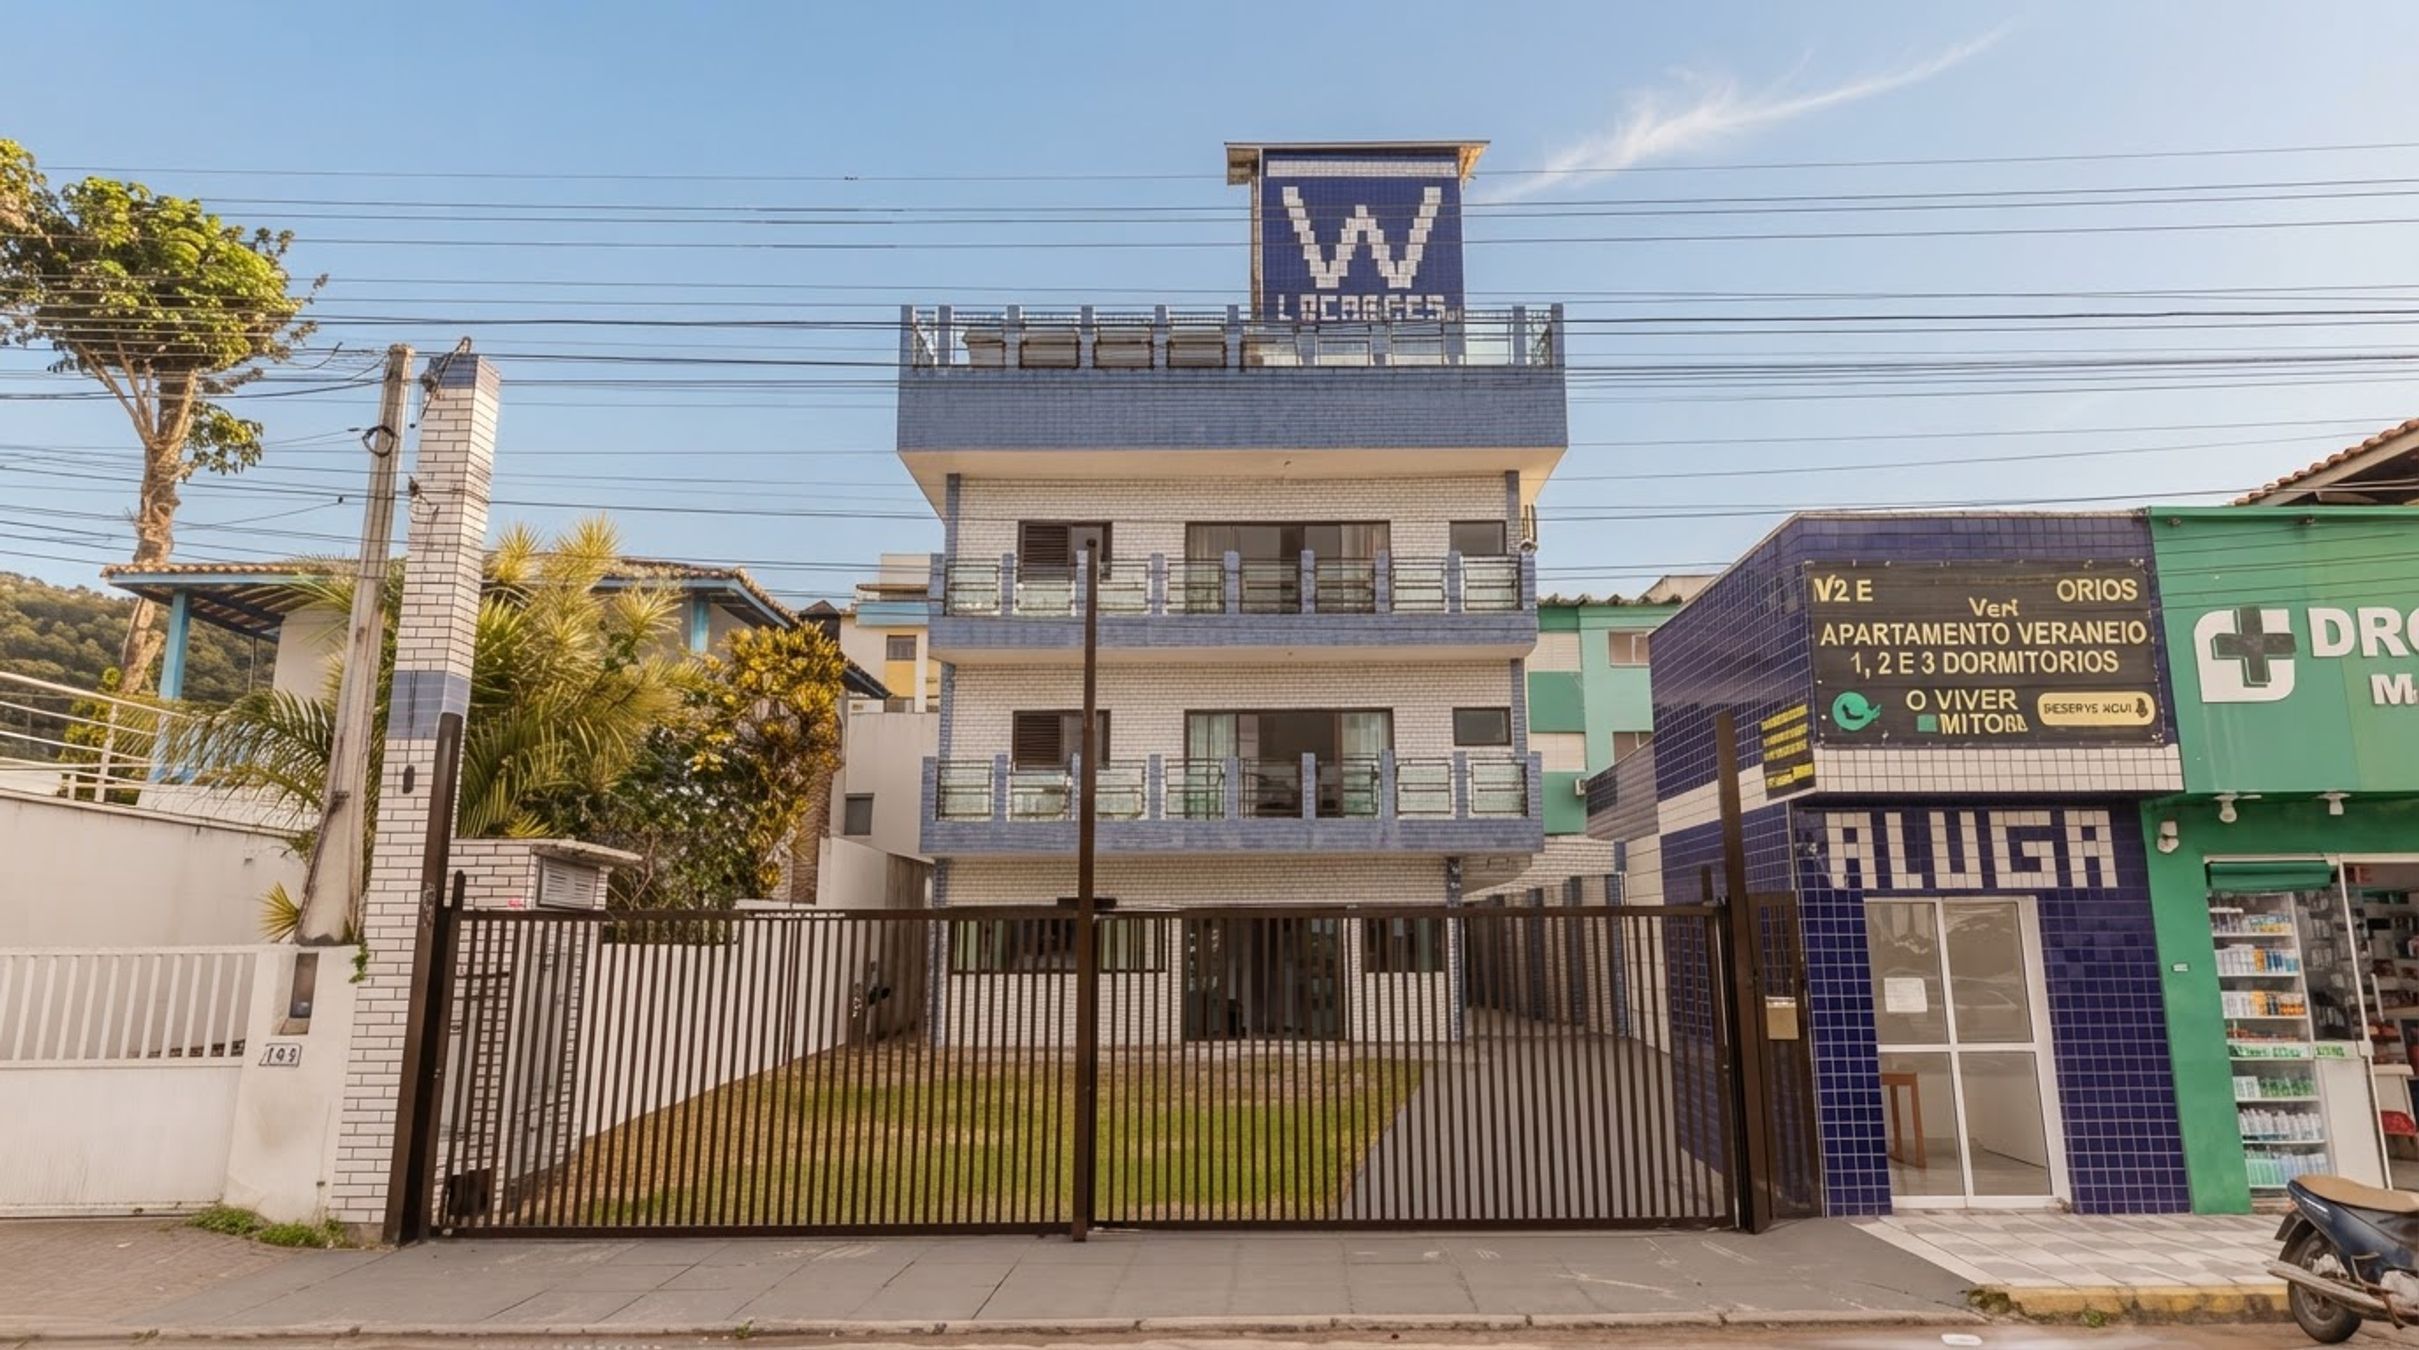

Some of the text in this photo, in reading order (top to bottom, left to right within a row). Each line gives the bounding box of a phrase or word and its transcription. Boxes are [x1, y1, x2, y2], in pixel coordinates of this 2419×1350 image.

[1282, 186, 1442, 288] W
[1856, 579, 1873, 602] E
[2056, 578, 2138, 602] ORIOS
[1819, 620, 2147, 646] APARTAMENTO VERANEIO
[2308, 607, 2419, 657] DR
[1878, 652, 1892, 675] 2
[1900, 652, 1914, 674] E
[1921, 652, 1935, 675] 3
[1943, 650, 2120, 674] DORMITORIOS
[1906, 688, 2019, 711] O VIVER
[2371, 673, 2419, 705] M
[1825, 809, 2118, 889] ALUGA
